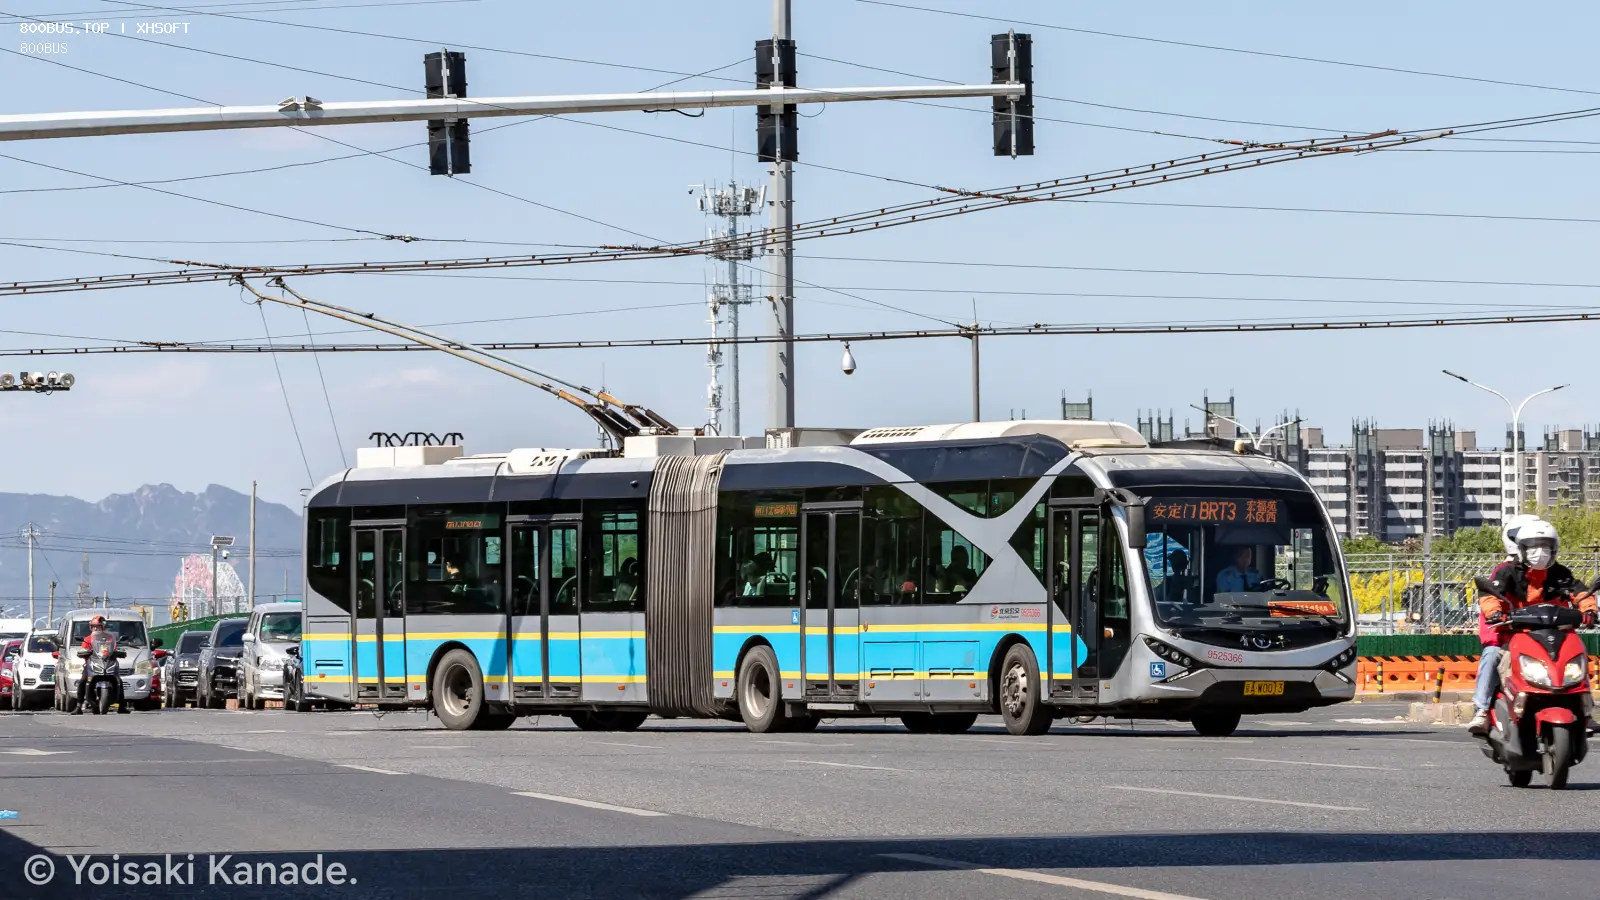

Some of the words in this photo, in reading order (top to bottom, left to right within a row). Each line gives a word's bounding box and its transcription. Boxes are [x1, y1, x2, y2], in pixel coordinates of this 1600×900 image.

[1153, 503, 1197, 519] 安定门
[1199, 501, 1237, 520] BRT3
[1245, 511, 1277, 523] 小区西
[1207, 649, 1243, 664] 9525366
